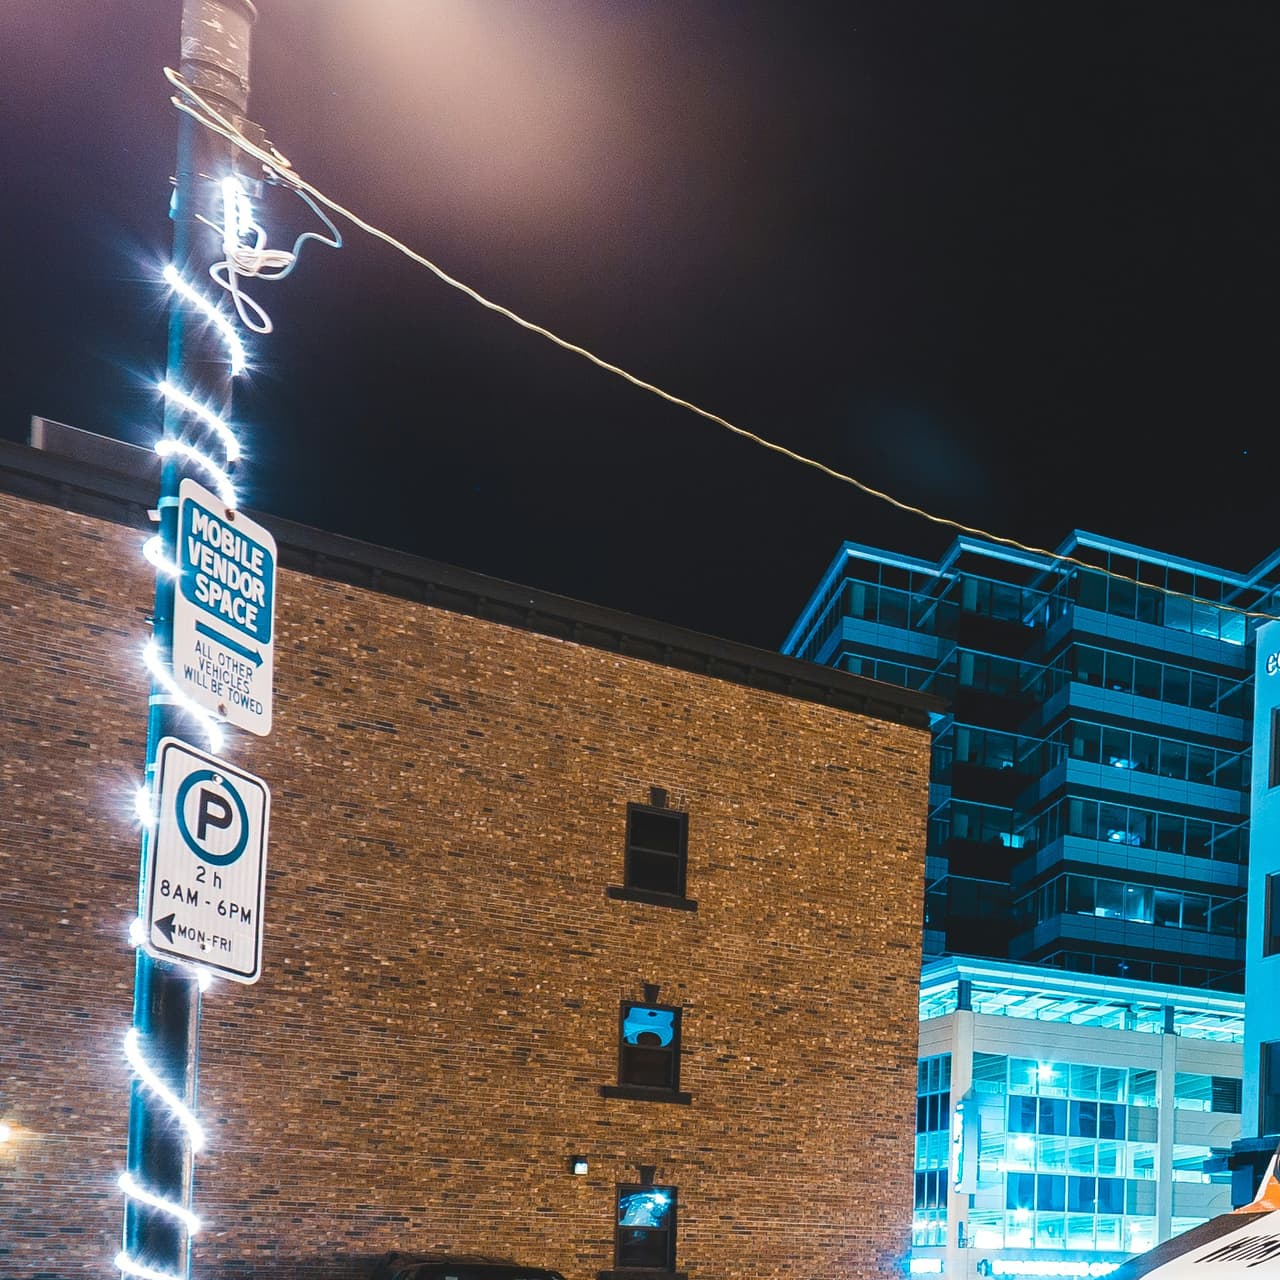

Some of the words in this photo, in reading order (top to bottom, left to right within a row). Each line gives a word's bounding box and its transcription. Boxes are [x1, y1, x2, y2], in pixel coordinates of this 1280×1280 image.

[192, 508, 264, 576] MOBILE
[188, 536, 265, 607] VENDOR
[195, 573, 257, 632] SPACE
[195, 640, 212, 660] ALL
[218, 652, 253, 681] OTHER
[199, 657, 250, 694] VEHICLES
[184, 664, 208, 689] WILL
[211, 679, 223, 696] BE
[228, 688, 263, 715] TOWED
[197, 787, 233, 841] P
[196, 866, 206, 883] 2
[213, 872, 222, 889] h
[160, 880, 198, 907] 8AM
[218, 900, 252, 925] 6PM
[178, 924, 232, 952] MON-FRI
